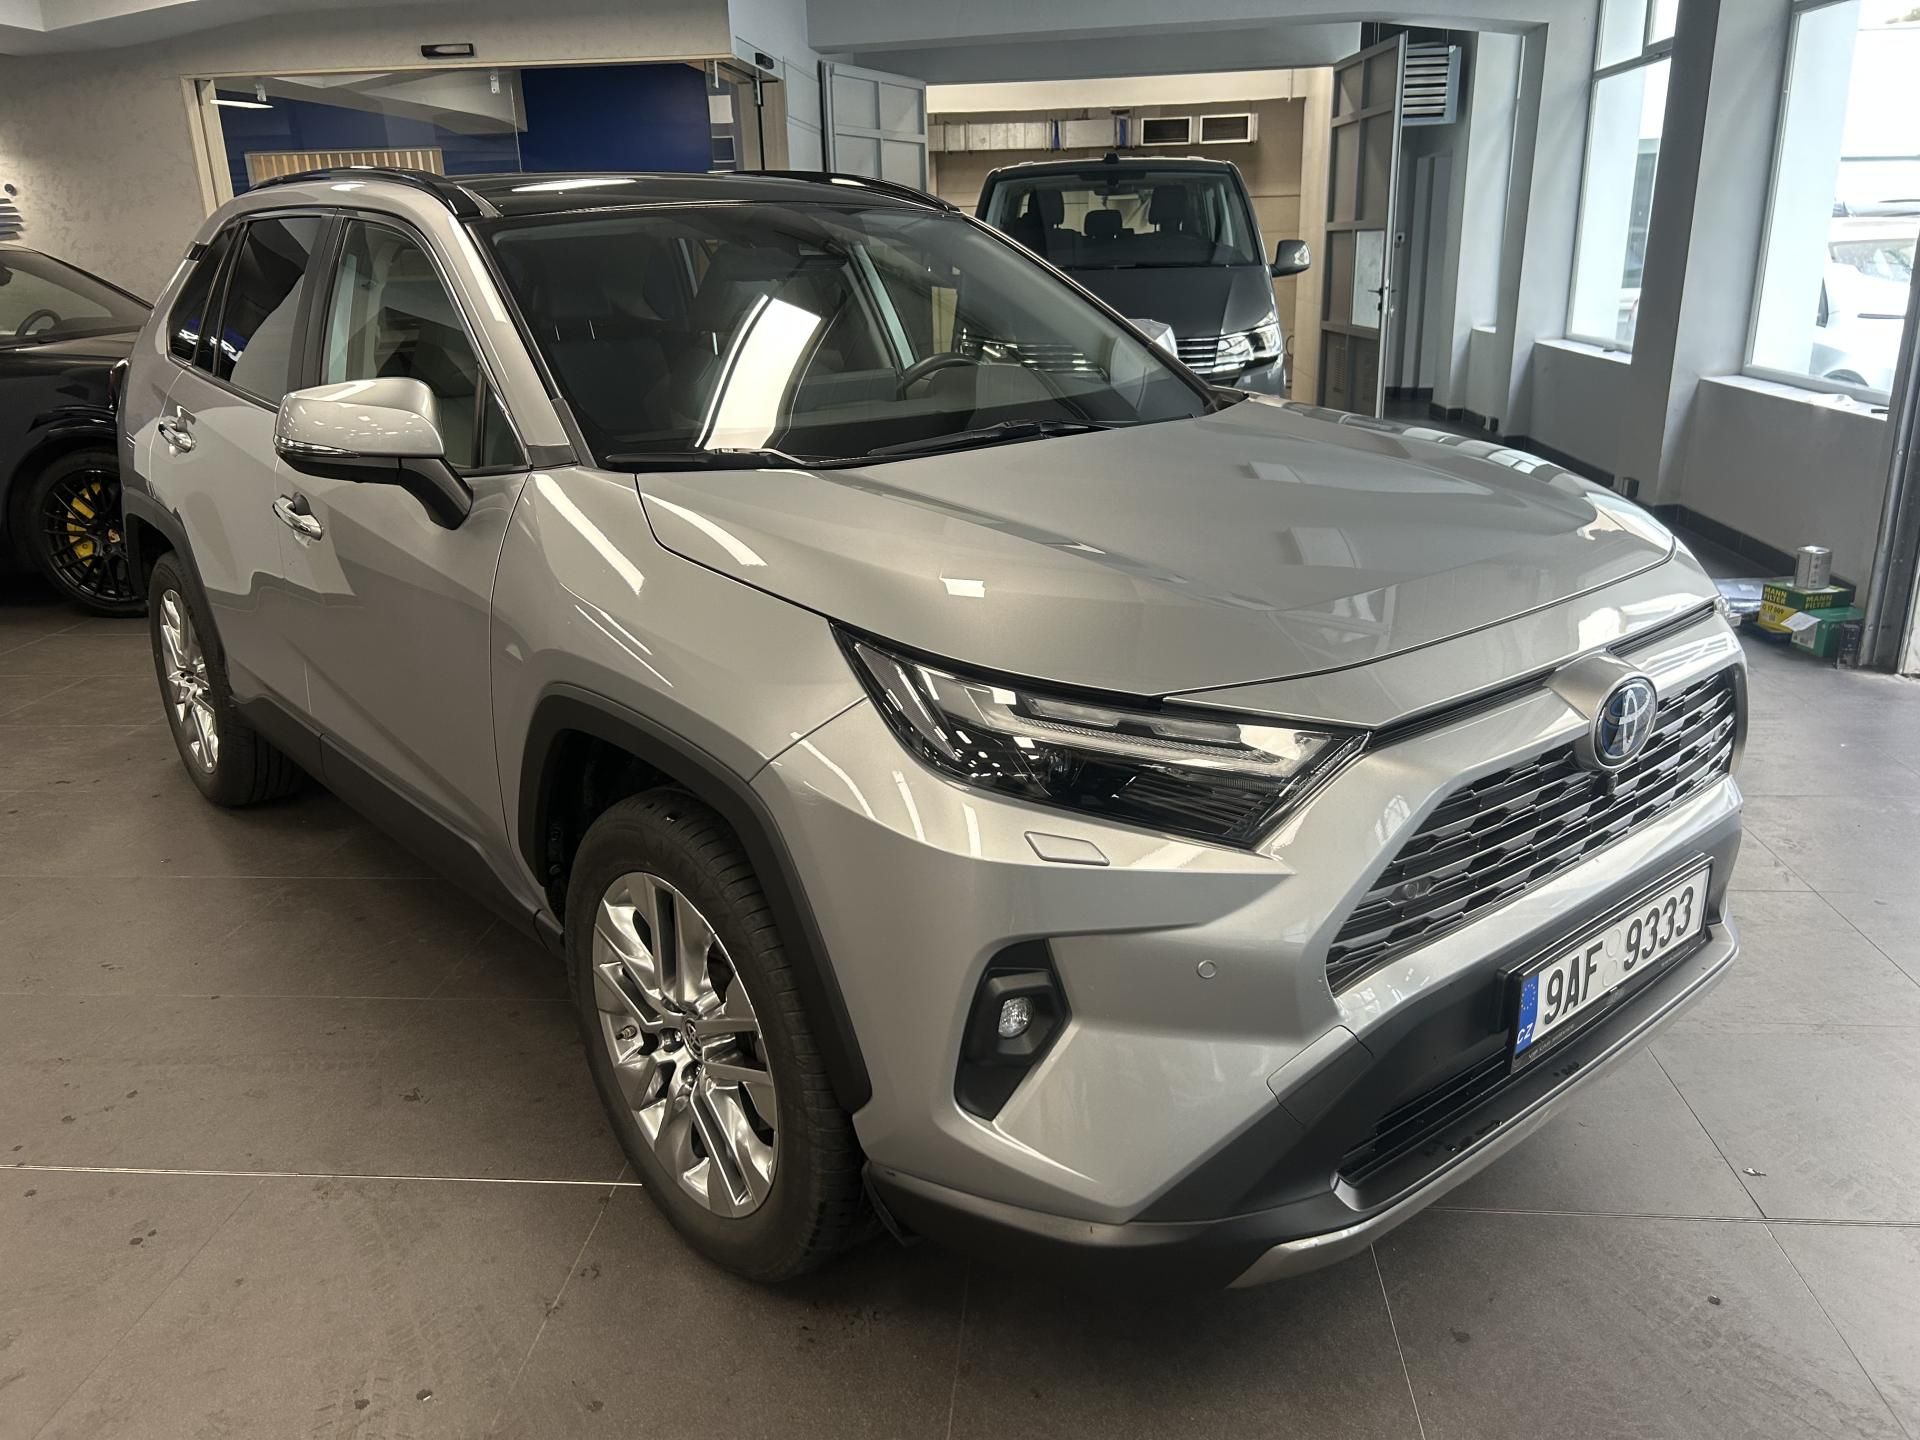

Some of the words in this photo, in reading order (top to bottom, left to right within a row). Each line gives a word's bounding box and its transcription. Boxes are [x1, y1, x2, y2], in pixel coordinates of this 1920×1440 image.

[1764, 585, 1787, 598] MANN
[1763, 592, 1786, 605] FILTER
[1805, 600, 1831, 609] FILTER
[1806, 594, 1832, 603] MANN
[1544, 940, 1603, 1025] 9AF
[1623, 886, 1694, 971] 9333
[1516, 1022, 1534, 1044] CZ
